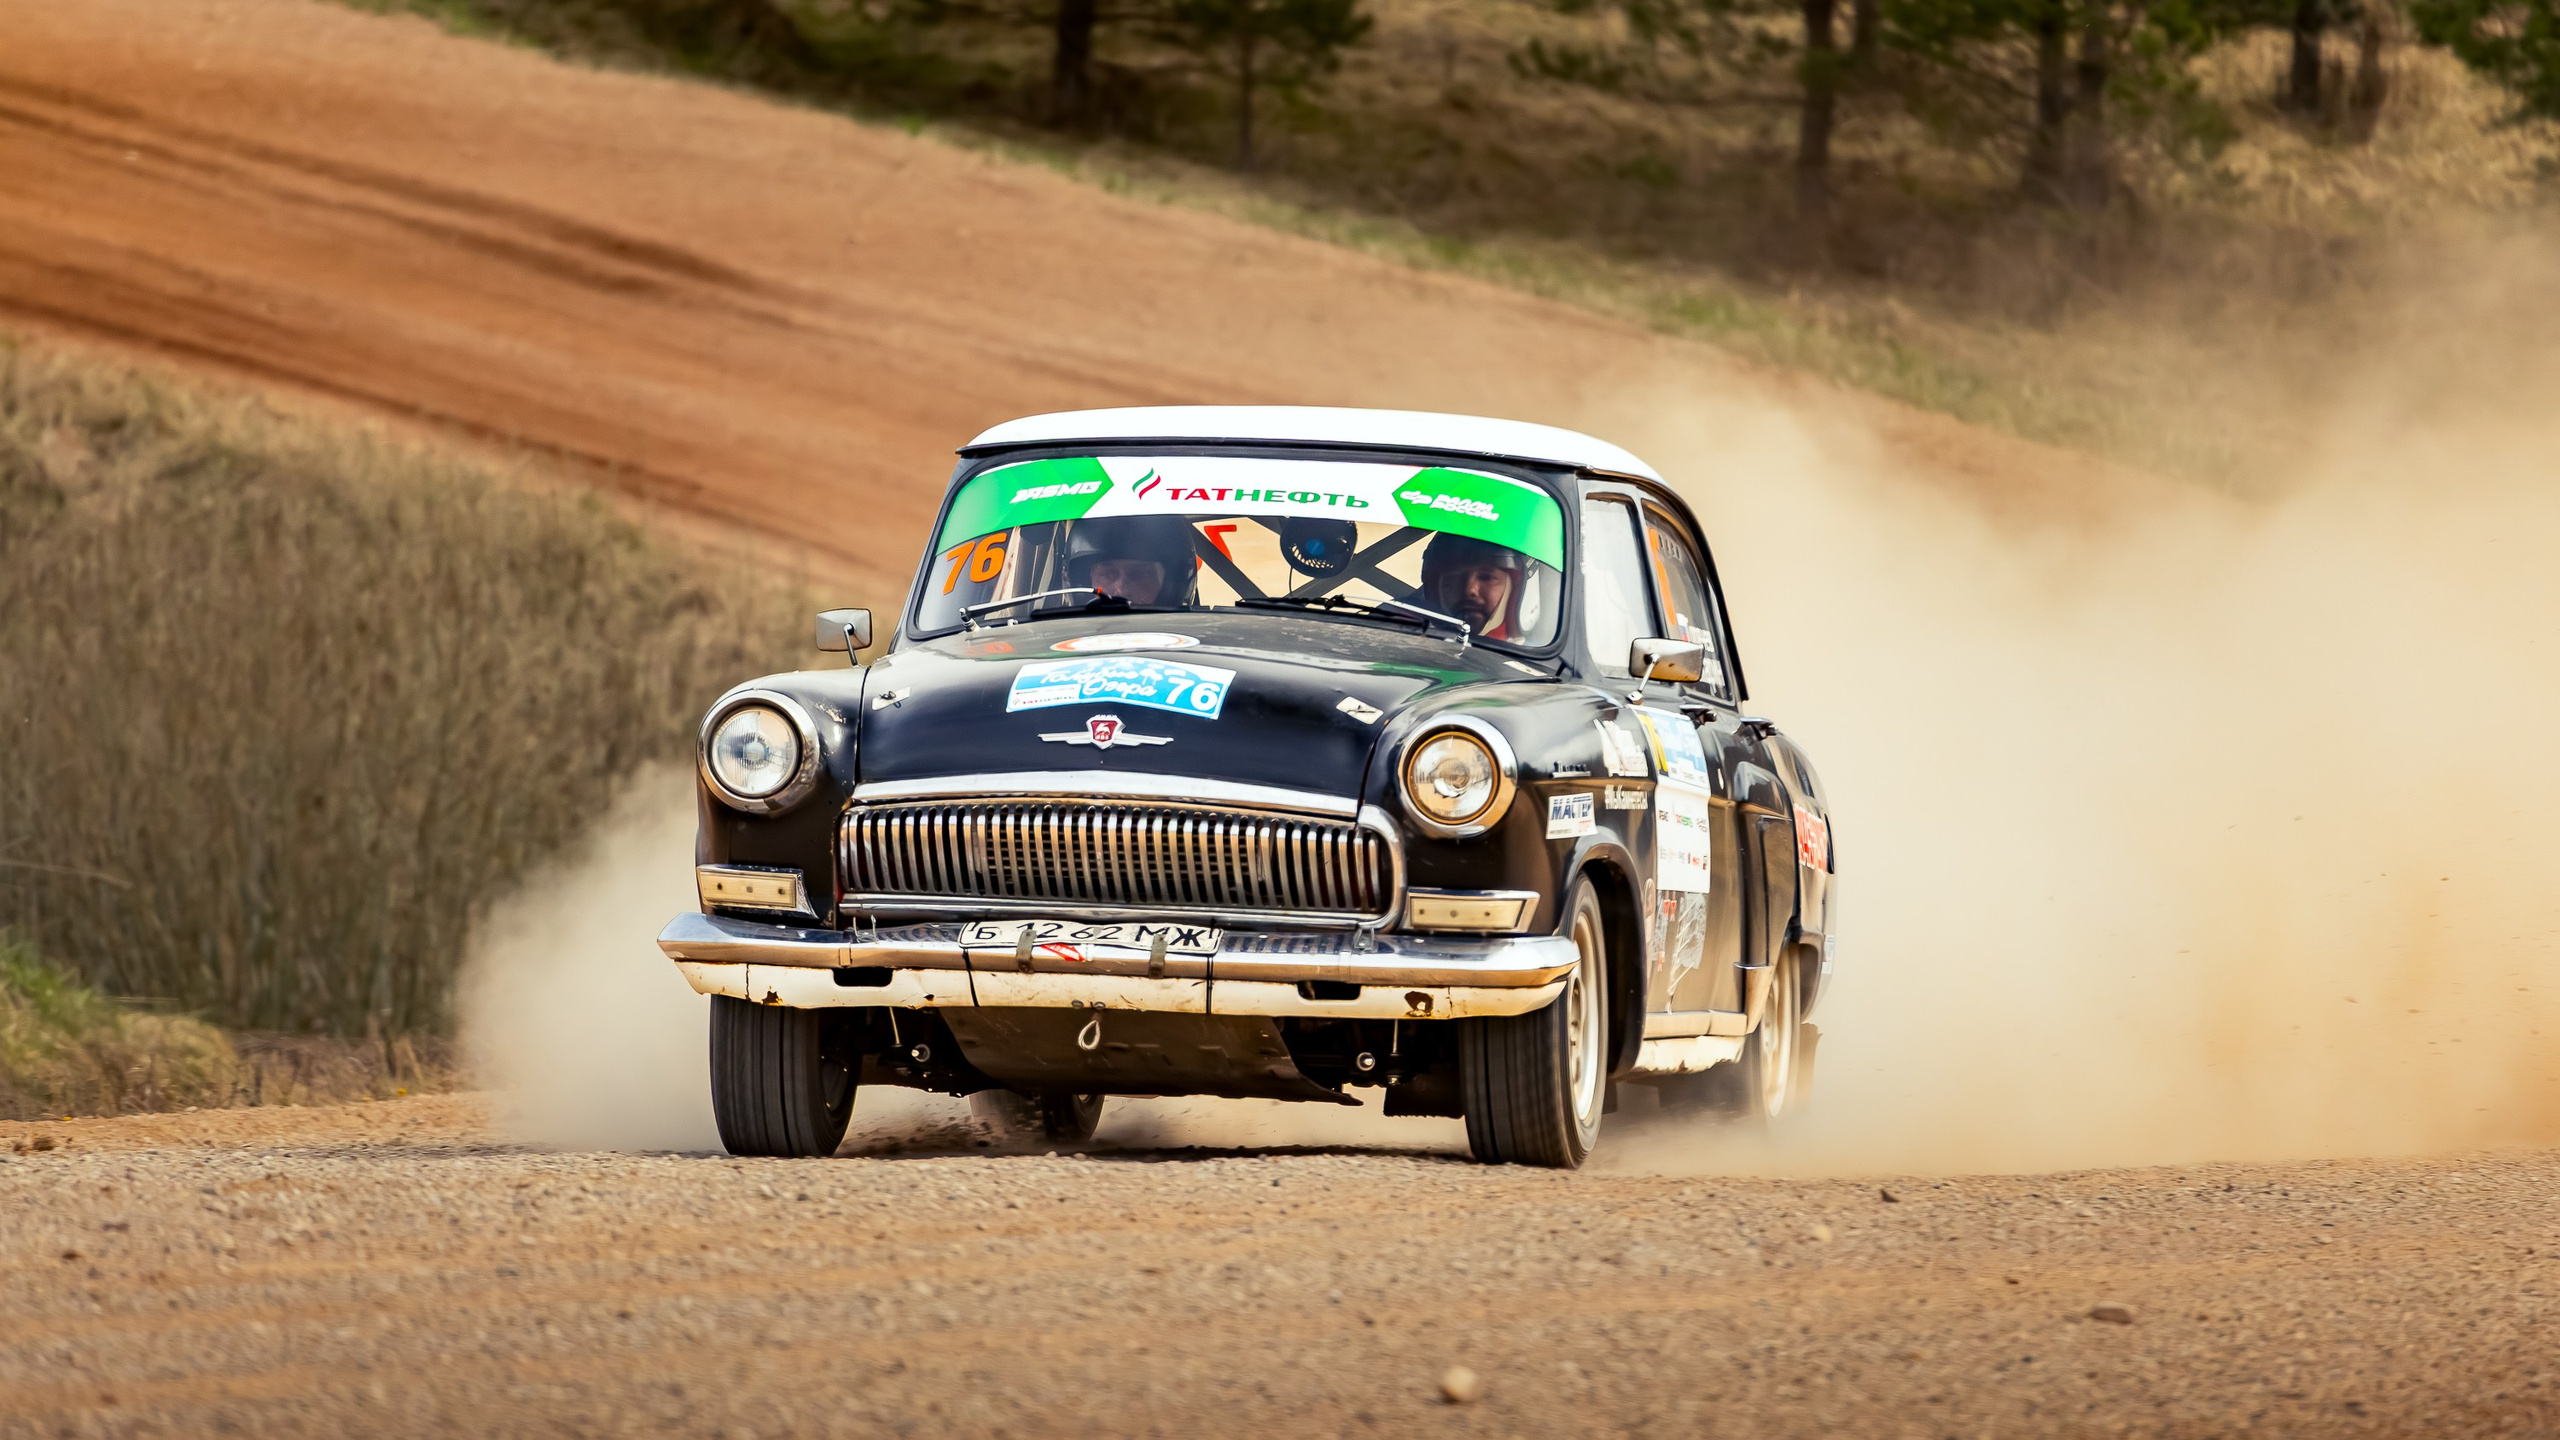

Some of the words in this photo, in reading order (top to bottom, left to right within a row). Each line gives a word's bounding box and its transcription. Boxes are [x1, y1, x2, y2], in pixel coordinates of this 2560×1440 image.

[1166, 488, 1369, 508] ТАТНЕФТЬ
[942, 532, 1007, 595] 76
[1165, 677, 1221, 712] 76
[1134, 924, 1208, 948] МЖ
